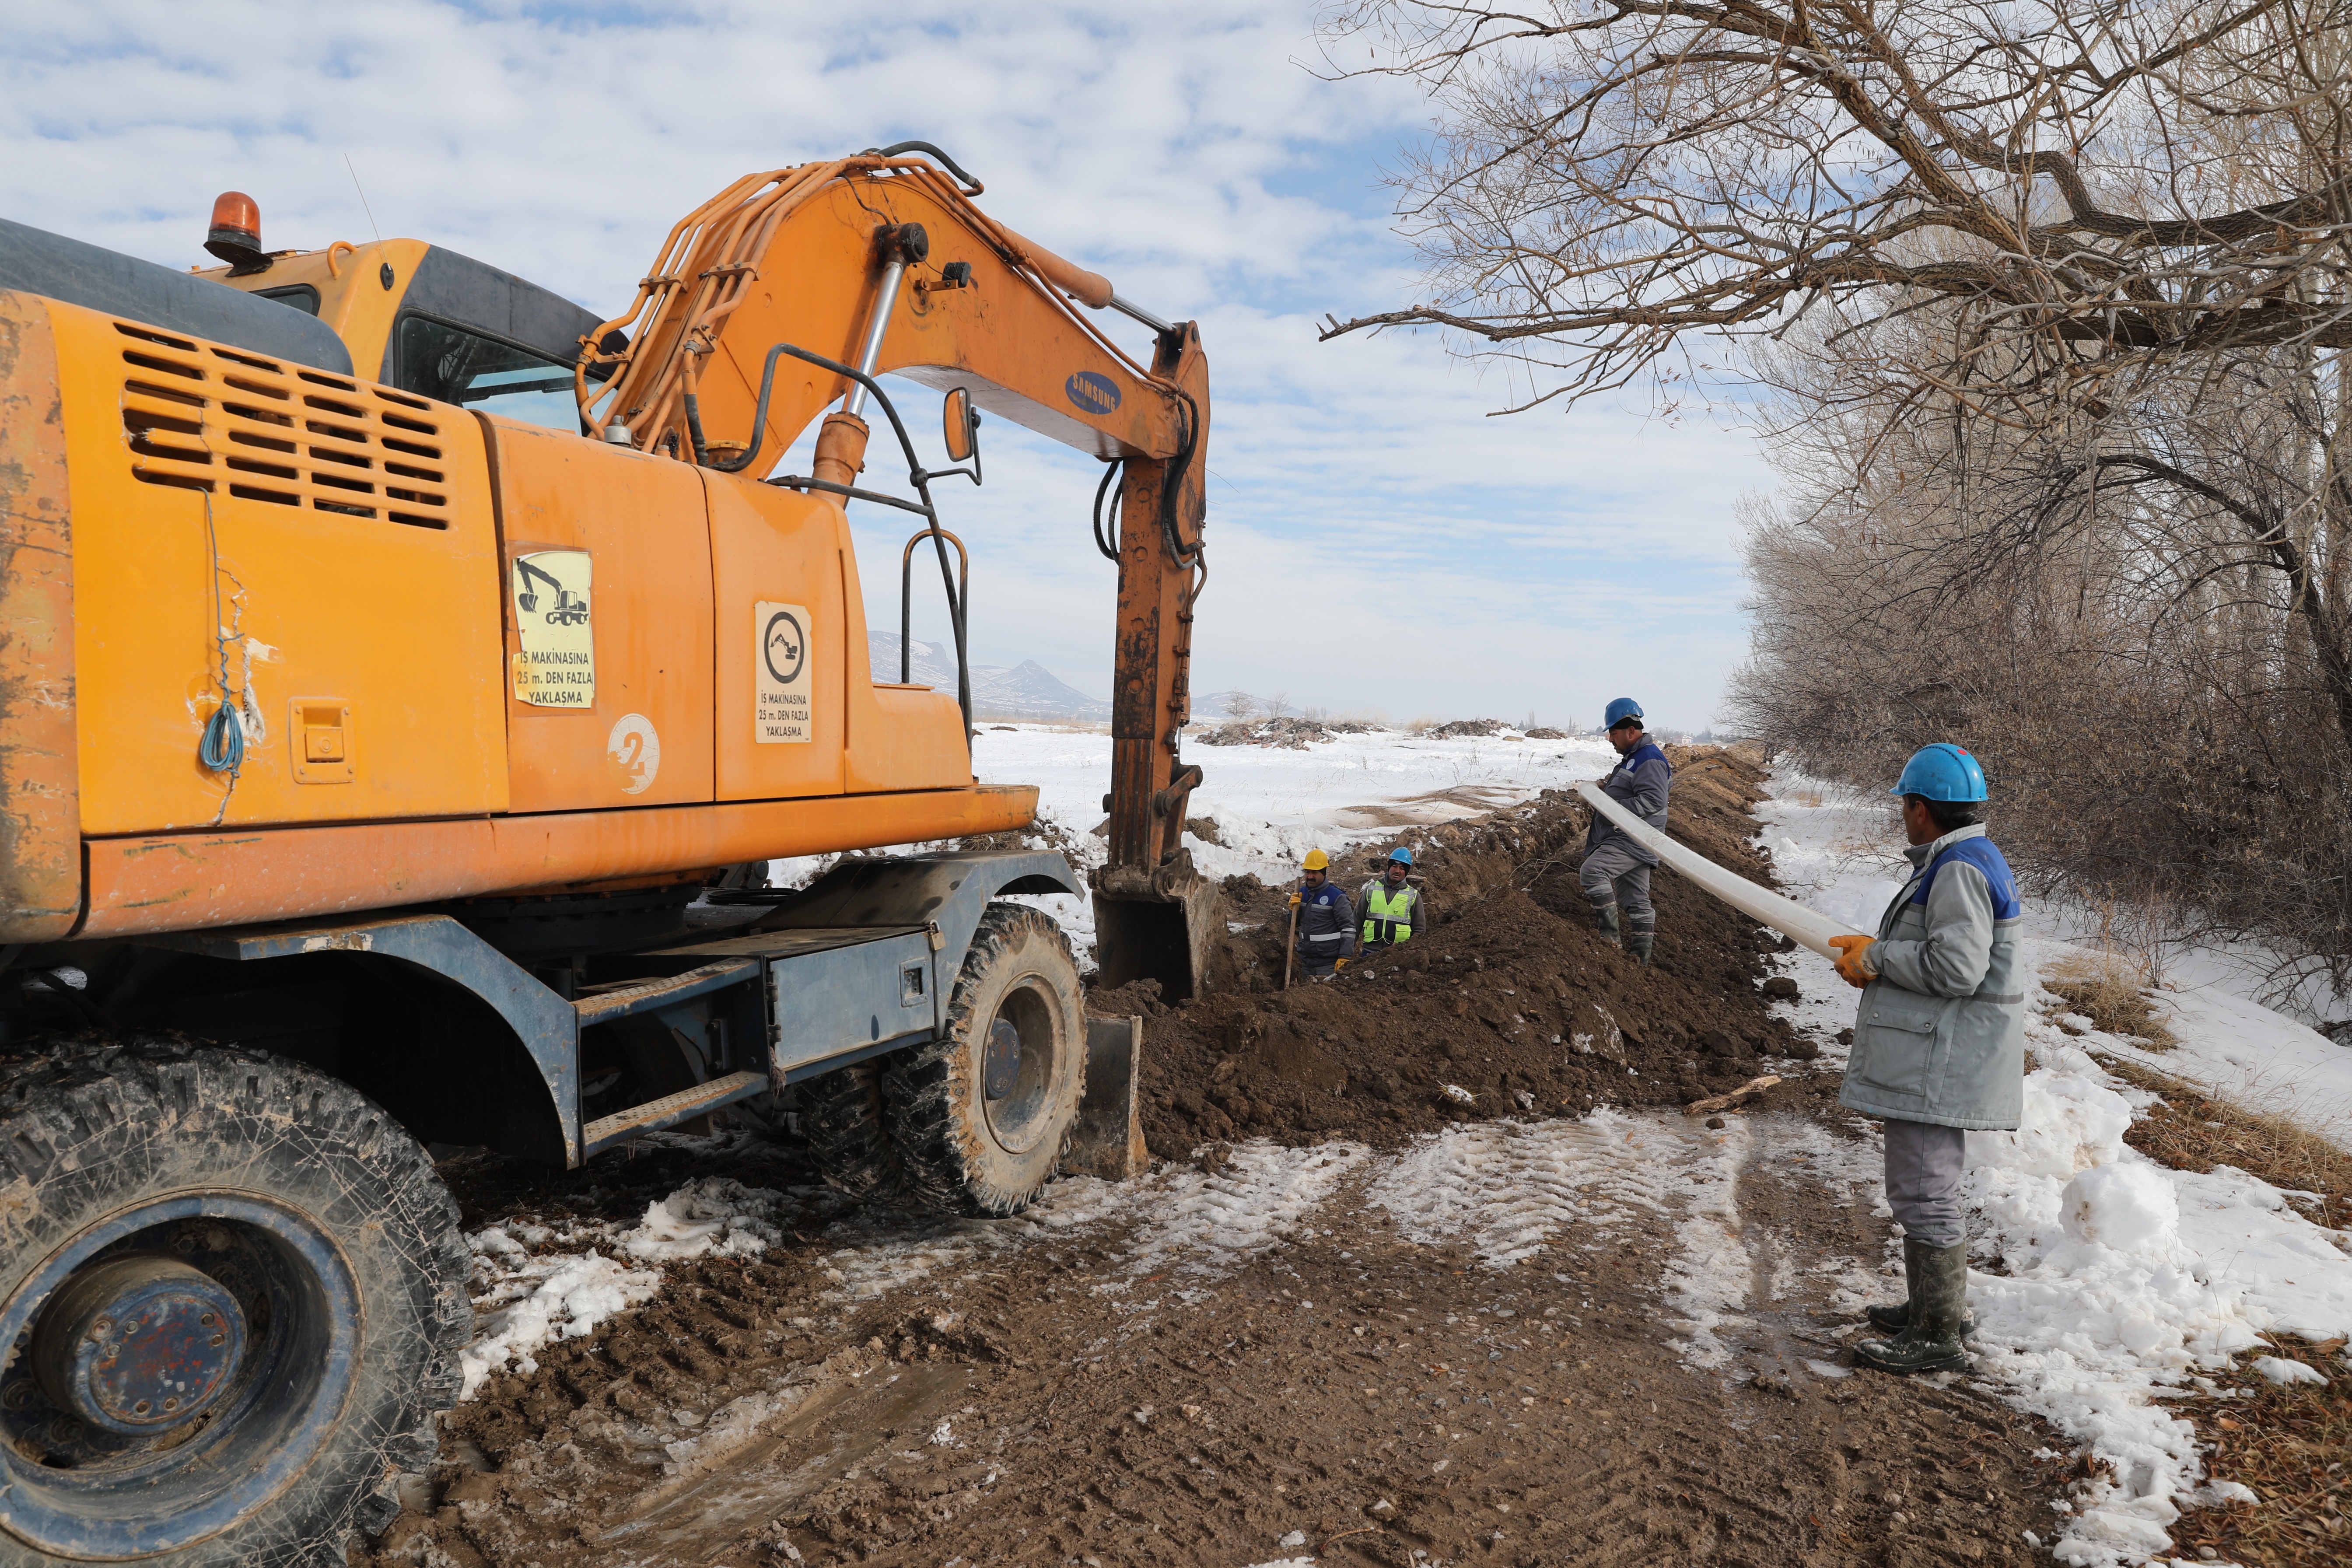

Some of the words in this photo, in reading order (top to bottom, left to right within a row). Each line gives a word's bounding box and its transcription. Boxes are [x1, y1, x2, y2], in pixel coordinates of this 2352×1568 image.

[1073, 373, 1115, 412] SAMSUNG
[531, 648, 589, 665] MAKİNASINA
[517, 671, 528, 684] 25
[532, 673, 542, 684] m.
[546, 672, 564, 684] DEN
[567, 672, 592, 684] FAZLA
[528, 691, 583, 706] YAKLAŞMA
[761, 690, 766, 706] İŞ
[768, 691, 806, 705] MAKİNASINA
[759, 709, 766, 720] 25
[778, 710, 789, 721] DEN
[791, 710, 808, 721] FAZLA
[766, 726, 802, 739] YAKLAŞMA
[624, 732, 644, 777] 2
